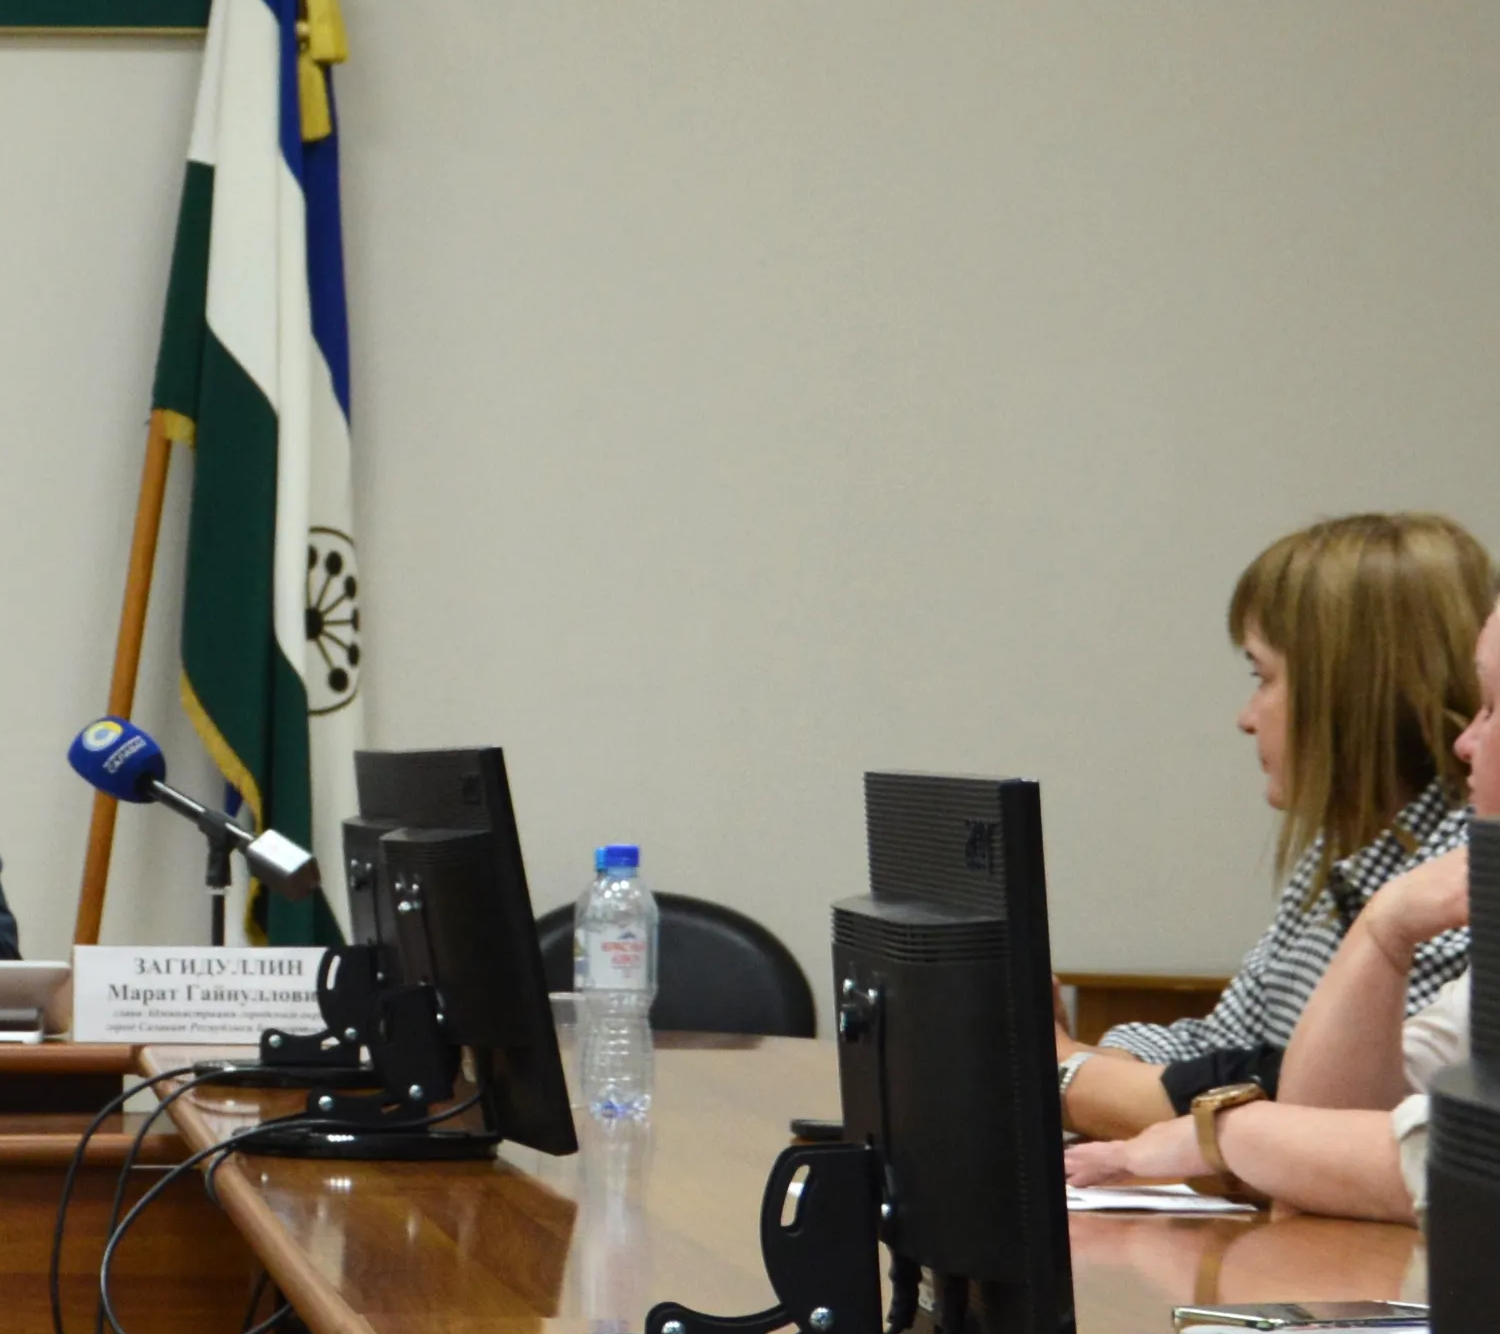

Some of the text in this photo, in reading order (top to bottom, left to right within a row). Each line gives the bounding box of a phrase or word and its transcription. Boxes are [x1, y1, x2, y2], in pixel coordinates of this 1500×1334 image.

[134, 957, 303, 976] ЗАГИДУЛЛИН
[107, 983, 318, 1007] Марат Гайнуллови
